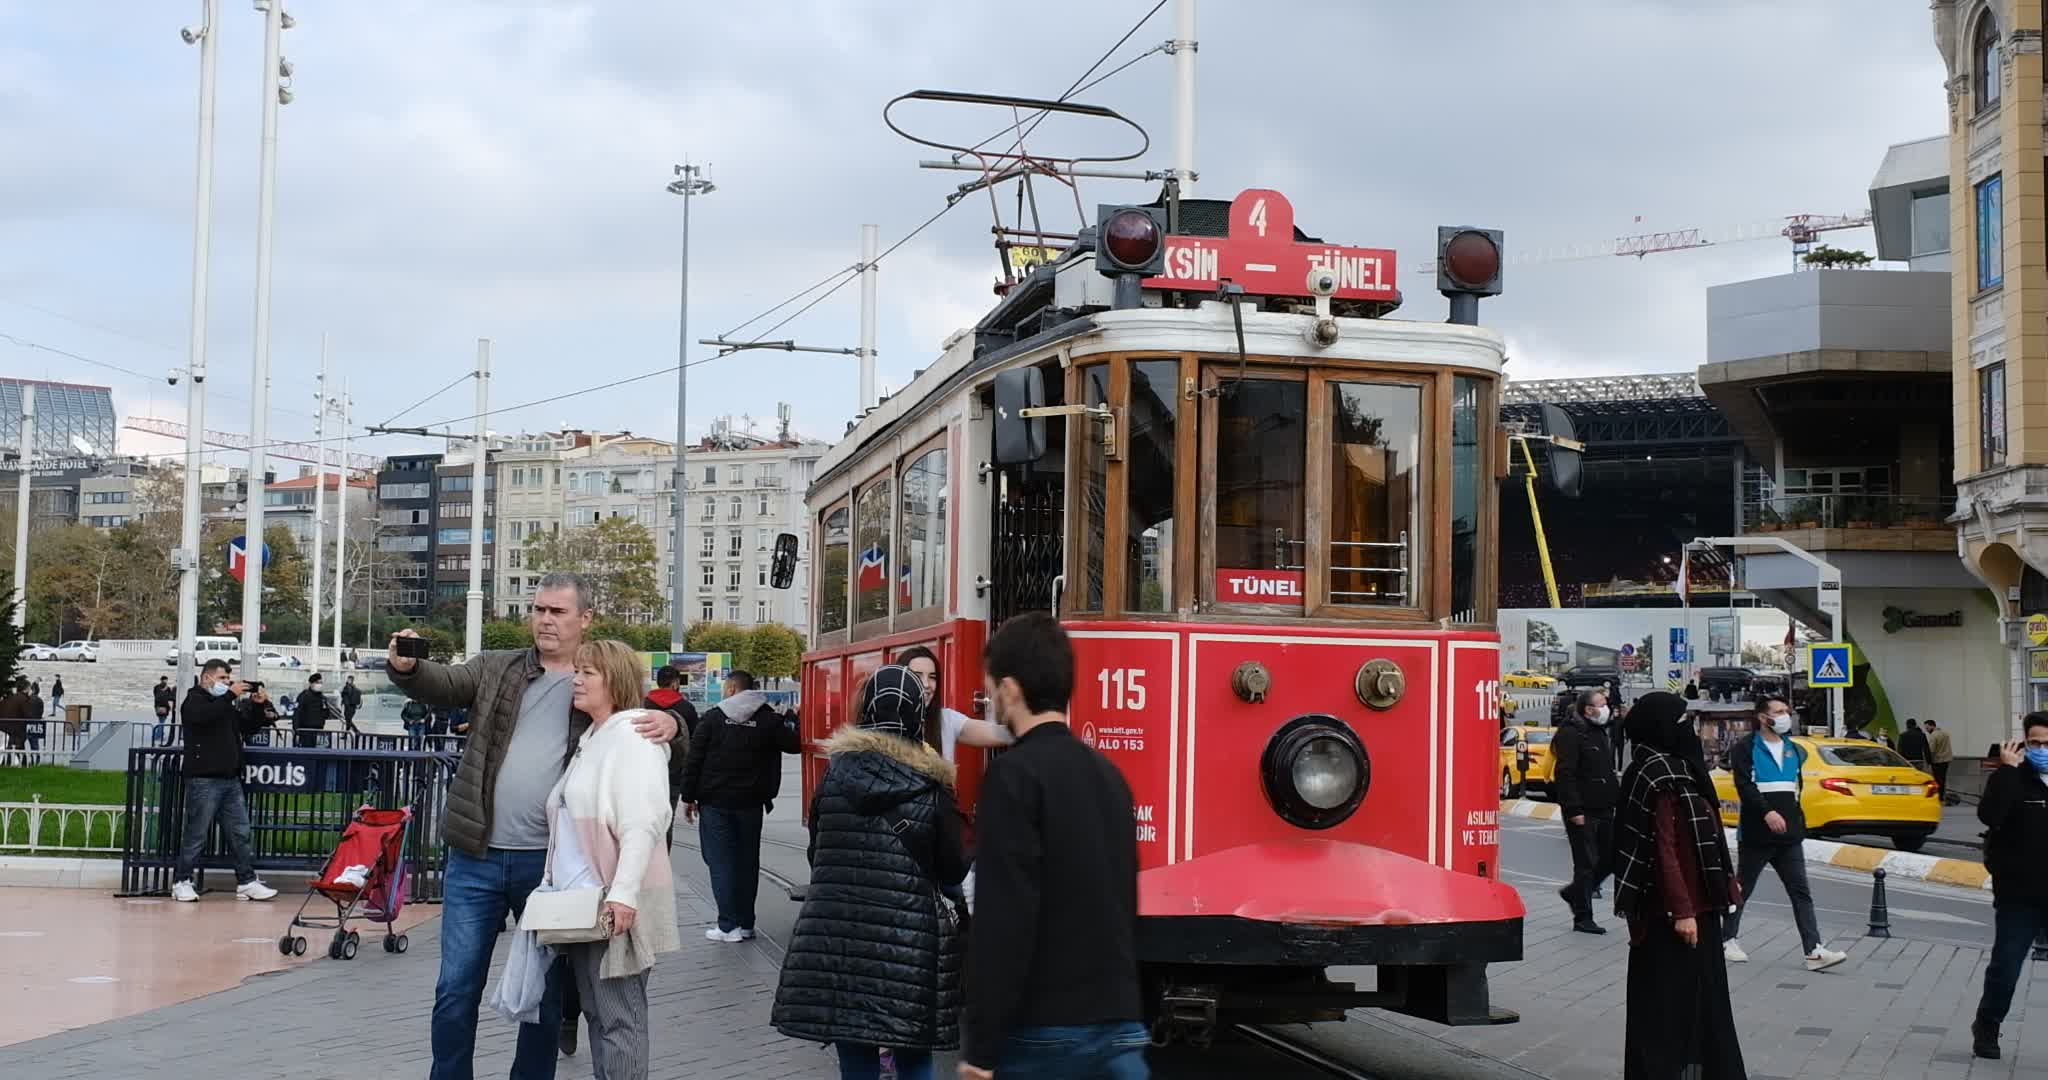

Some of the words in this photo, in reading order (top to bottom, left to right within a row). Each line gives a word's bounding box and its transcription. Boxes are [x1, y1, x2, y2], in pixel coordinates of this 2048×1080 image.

[1248, 199, 1267, 237] 4
[1153, 242, 1218, 281] KSİM
[1307, 250, 1392, 291] TÜNEL
[60, 459, 88, 470] HOTEL
[1229, 576, 1302, 596] TÜNEL
[1098, 668, 1146, 710] 115
[1098, 739, 1120, 750] ALO
[1123, 740, 1144, 751] 153
[245, 762, 306, 787] POLİS
[1462, 830, 1475, 846] VE
